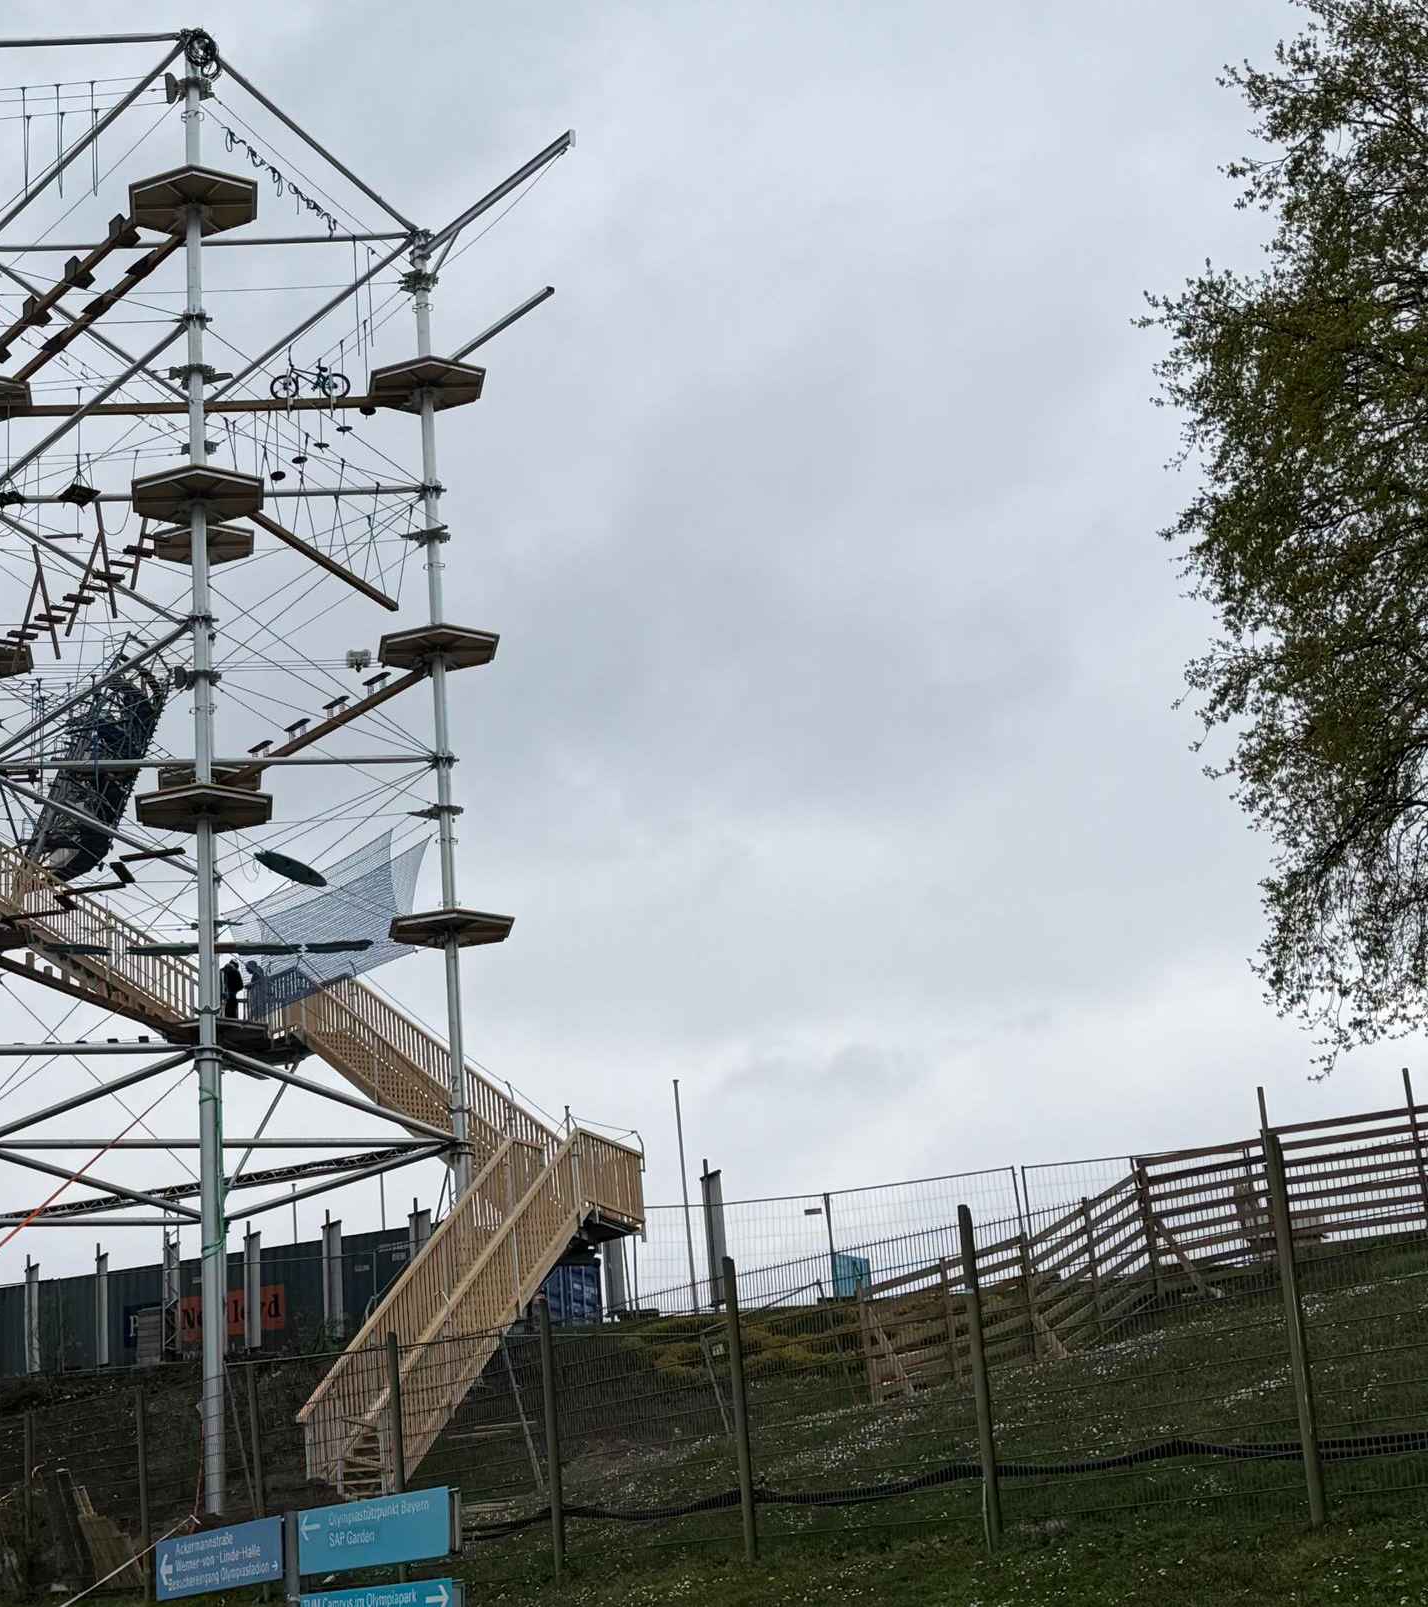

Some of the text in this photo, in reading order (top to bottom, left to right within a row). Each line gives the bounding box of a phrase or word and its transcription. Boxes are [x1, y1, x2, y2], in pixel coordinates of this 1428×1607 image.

[402, 1500, 429, 1514] Bayern
[176, 1532, 233, 1554] Ackermannstraße
[329, 1529, 375, 1547] SAP Garden
[220, 1562, 270, 1584] Olympiastadion
[366, 1588, 417, 1607] Olympiapark
